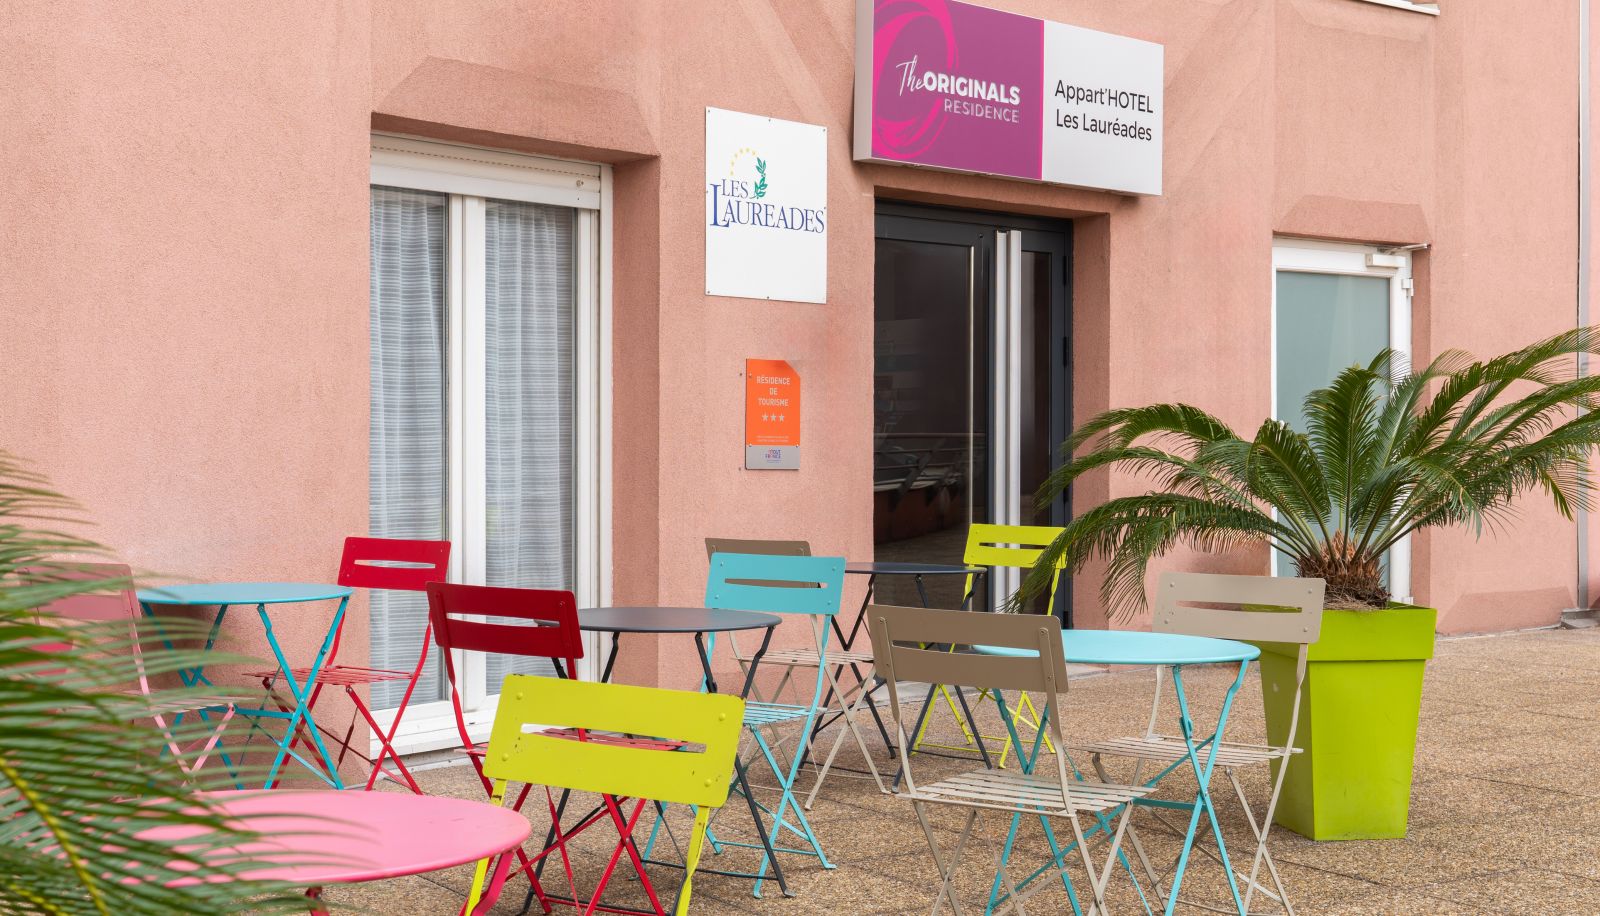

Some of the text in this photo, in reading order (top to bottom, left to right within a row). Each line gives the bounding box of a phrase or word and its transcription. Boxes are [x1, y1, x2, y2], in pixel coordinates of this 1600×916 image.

[944, 98, 1020, 123] RESIDENCE
[1055, 108, 1153, 141] Les Lauréades
[721, 178, 749, 199] LES
[709, 183, 825, 234] LAUREADES
[758, 398, 789, 407] TOURISME
[769, 387, 778, 396] DE
